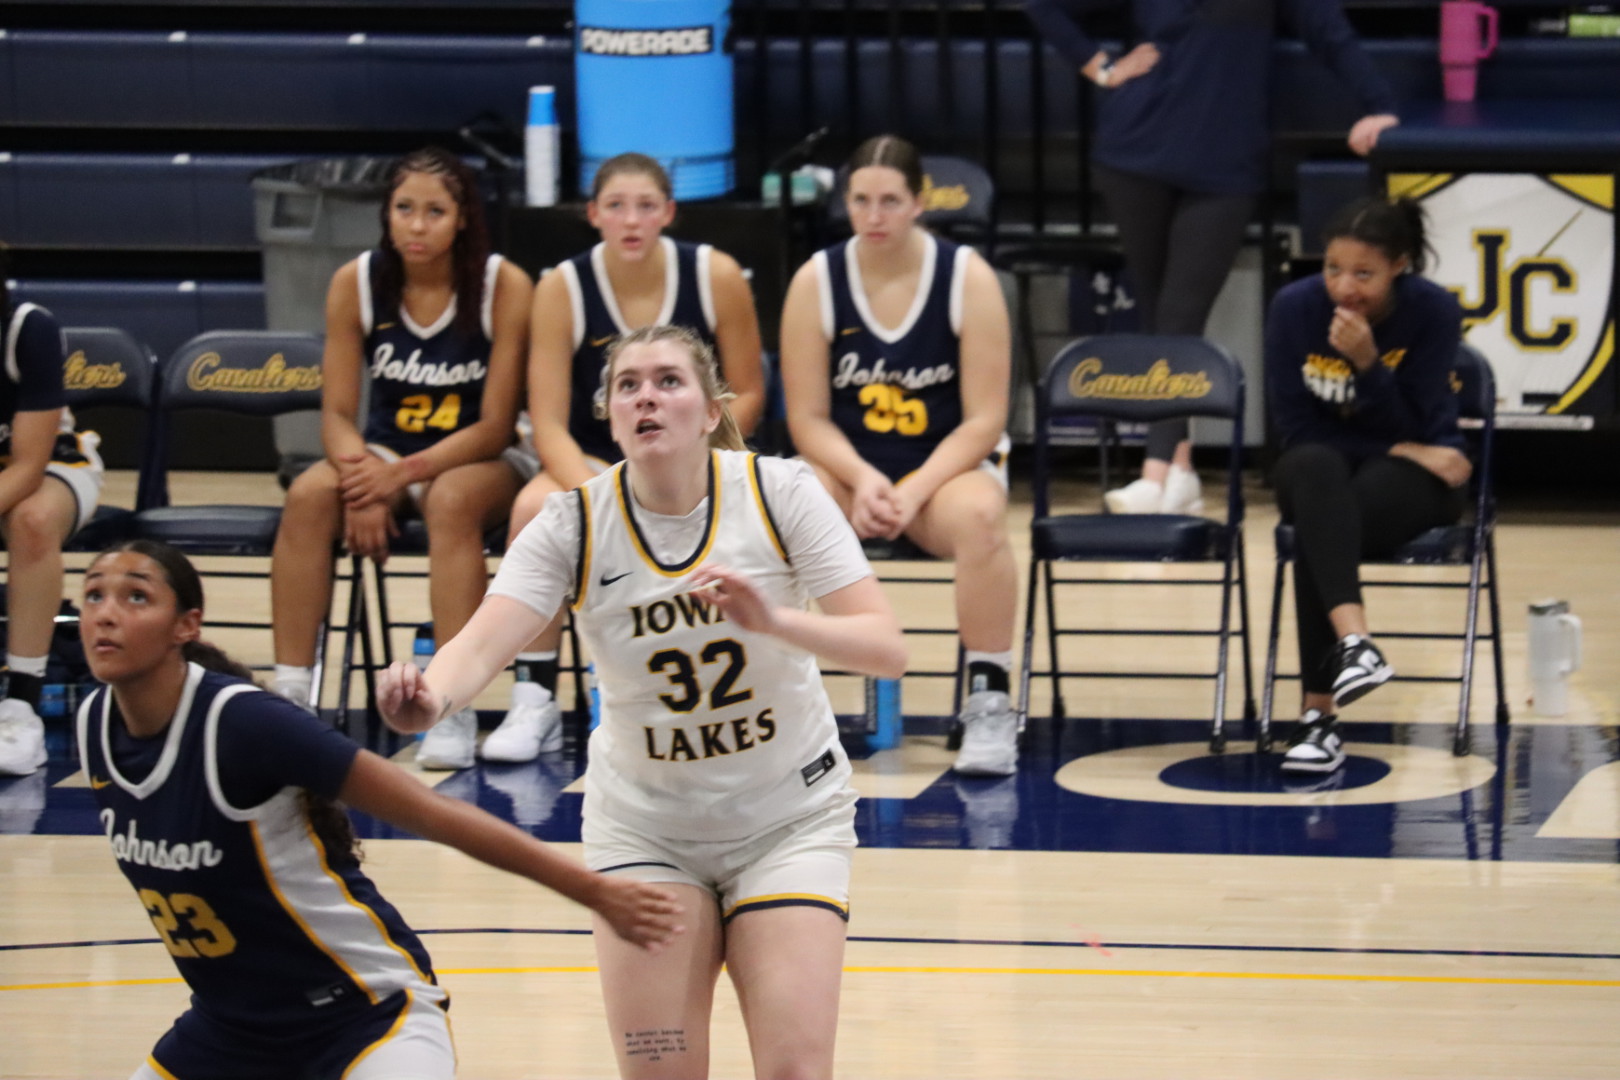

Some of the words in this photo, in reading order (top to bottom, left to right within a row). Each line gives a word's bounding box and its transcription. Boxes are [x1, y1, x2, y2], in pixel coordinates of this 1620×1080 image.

[578, 28, 710, 56] POWERADE
[1446, 228, 1578, 353] JC
[371, 342, 487, 386] Johnson
[833, 351, 954, 389] Johnson
[1068, 356, 1213, 400] Cavaliers
[395, 393, 461, 433] 24
[858, 383, 928, 436] 35
[629, 592, 726, 638] IOW
[647, 637, 753, 714] 32
[643, 707, 776, 762] LAKES
[100, 807, 223, 871] Johnson
[139, 888, 237, 958] 23
